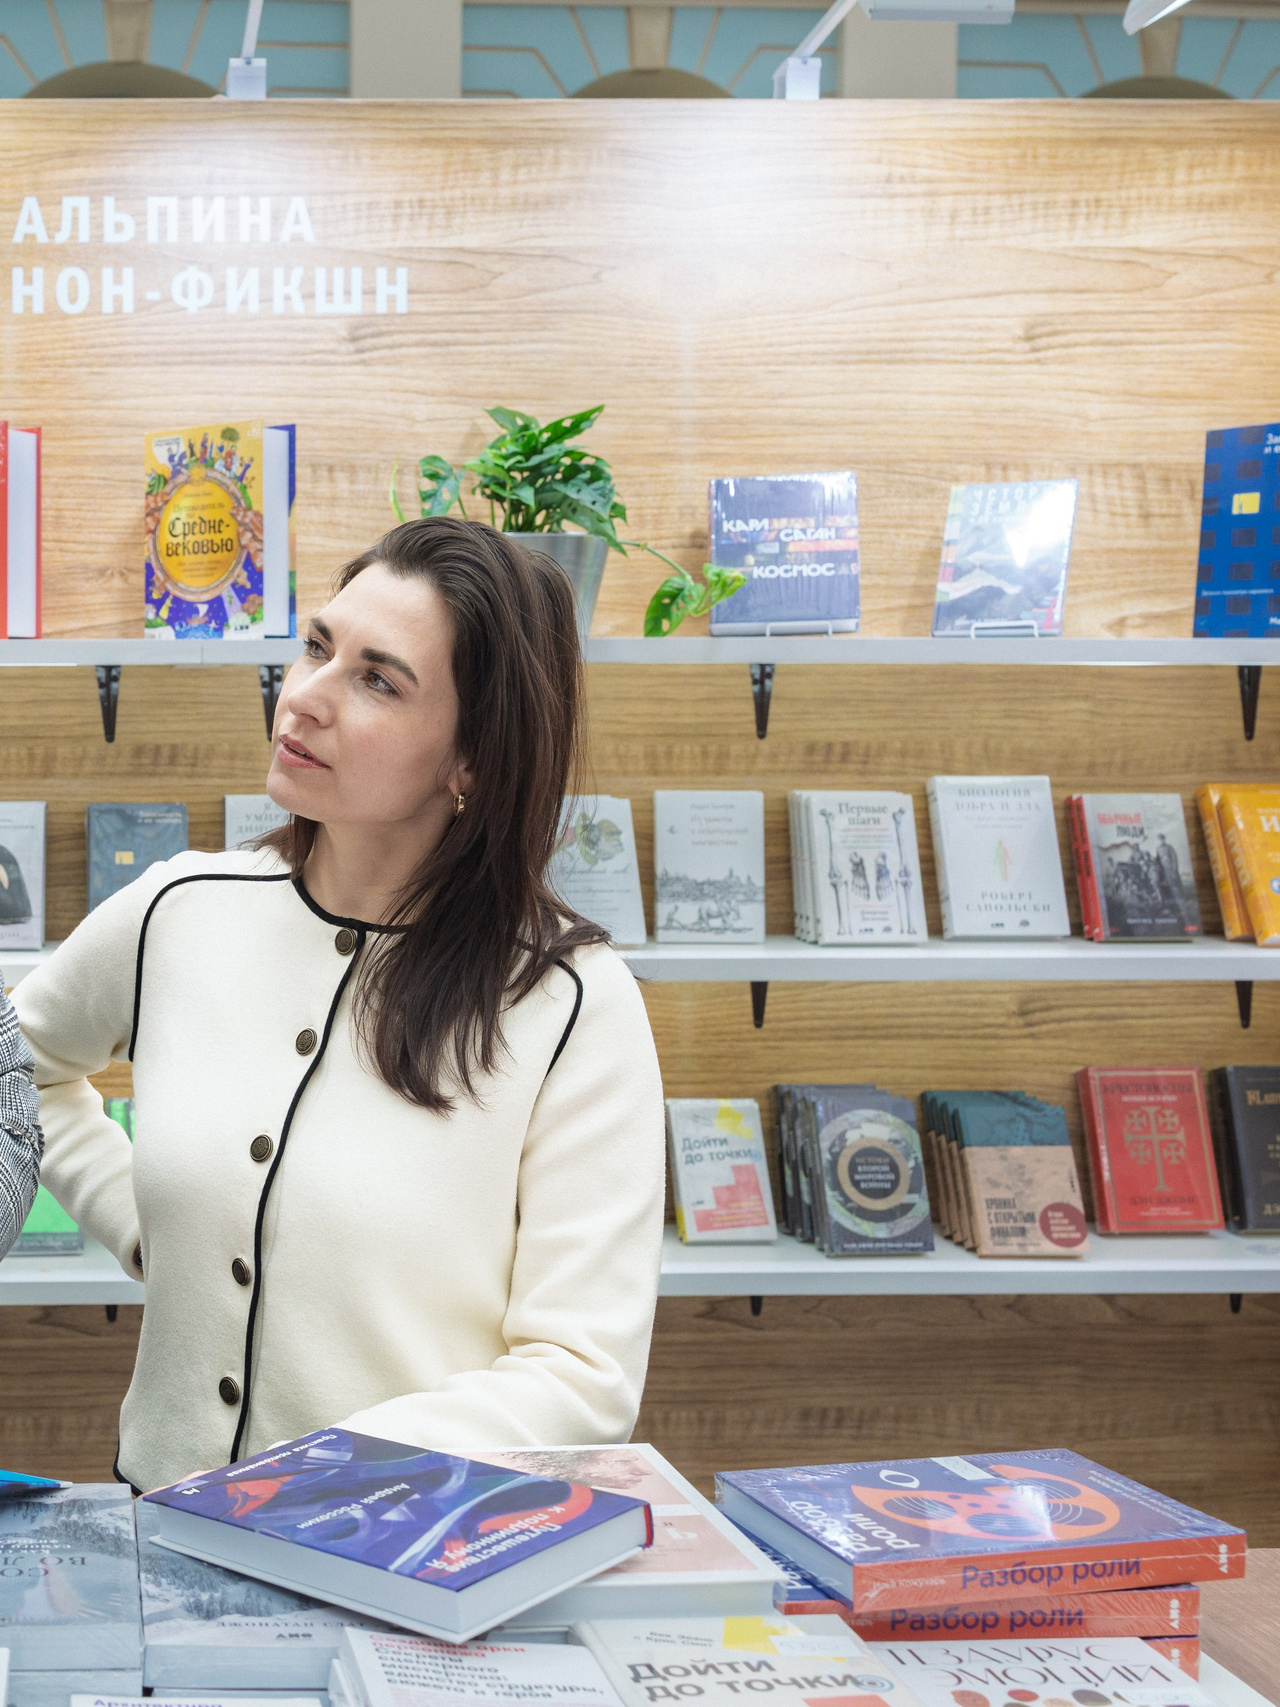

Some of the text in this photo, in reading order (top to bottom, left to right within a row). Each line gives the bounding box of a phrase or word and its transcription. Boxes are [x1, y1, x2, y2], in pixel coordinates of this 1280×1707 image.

[12, 196, 317, 244] АЛЬПИНА
[12, 266, 409, 315] НОН-ФИКШН
[168, 516, 231, 541] Средне-
[779, 527, 836, 542] САГАН
[166, 536, 233, 557] вековью
[753, 563, 836, 579] КОСМОС
[838, 803, 888, 815] Первые
[848, 817, 881, 828] шаги
[682, 1135, 728, 1153] Дойти
[684, 1151, 704, 1165] до
[291, 1434, 337, 1453] Практика
[296, 1482, 410, 1529] Андрей Россохин
[444, 1512, 550, 1560] подлинному
[842, 1513, 920, 1549] роли
[445, 1522, 562, 1573] Путешествие
[39, 1556, 87, 1566] ВО
[962, 1558, 1141, 1589] Разбор роли
[890, 1606, 1083, 1634] Разбор роли
[375, 1647, 463, 1663] Секреты
[475, 1644, 526, 1654] арки
[378, 1655, 499, 1673] сценарного
[627, 1658, 777, 1685] Дойти
[383, 1671, 605, 1695] единство структуры,
[386, 1678, 466, 1694] сюжета
[645, 1673, 863, 1703] до точки
